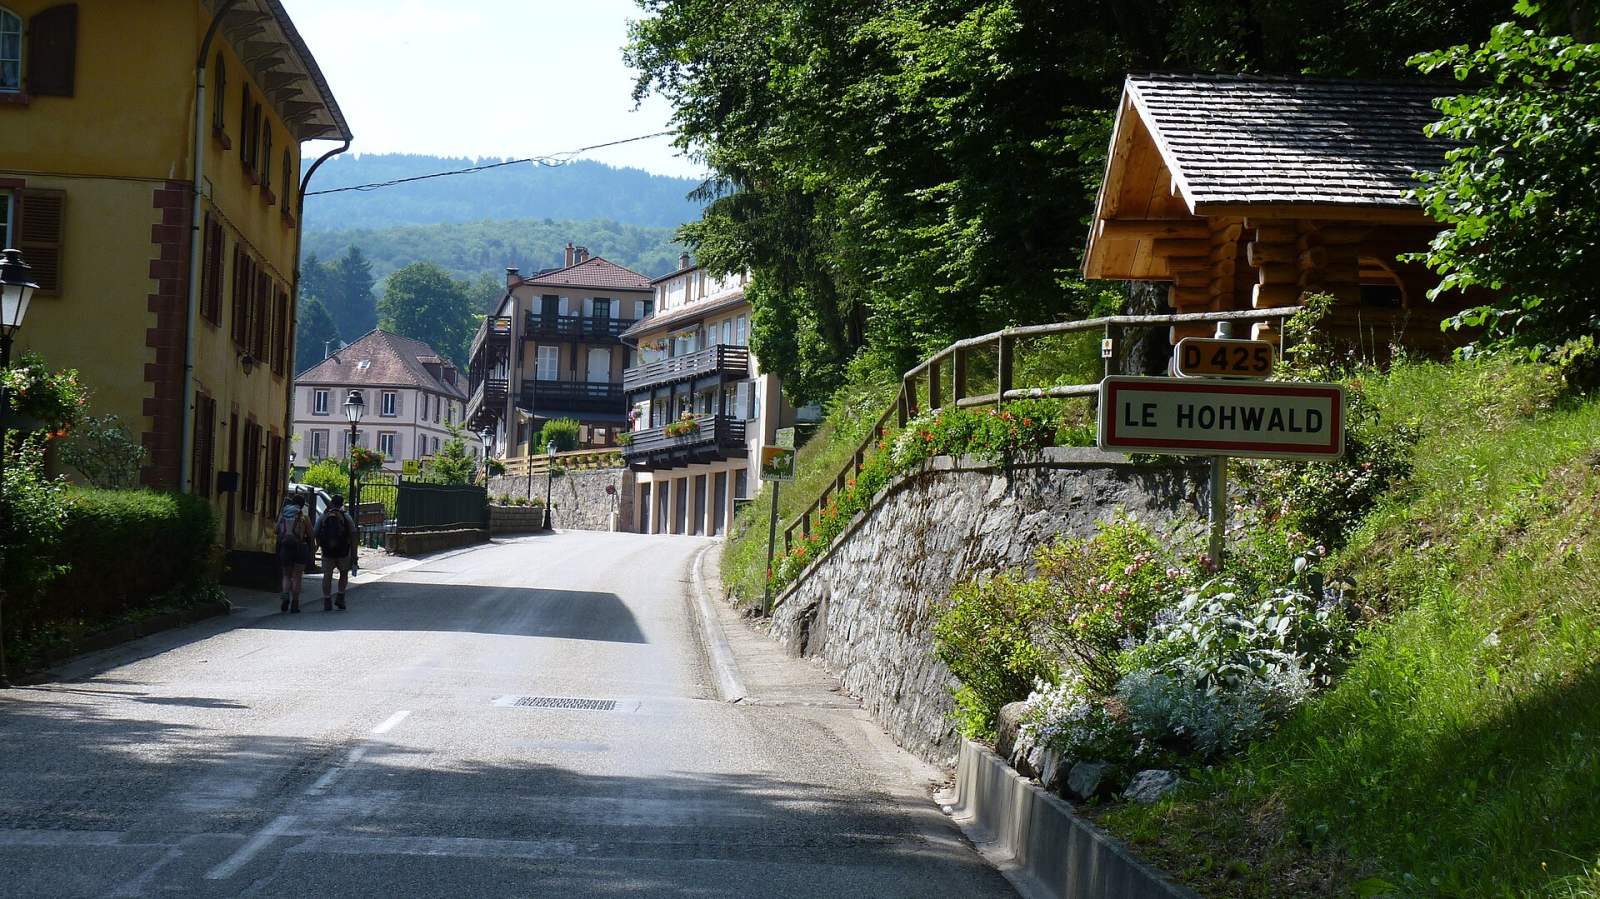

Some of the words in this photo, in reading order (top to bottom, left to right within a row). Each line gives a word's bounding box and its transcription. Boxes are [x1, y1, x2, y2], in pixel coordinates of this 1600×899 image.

[1185, 346, 1200, 369] D
[1211, 347, 1268, 371] 425
[1124, 402, 1158, 427] LE
[1177, 404, 1323, 433] HOHWALD
